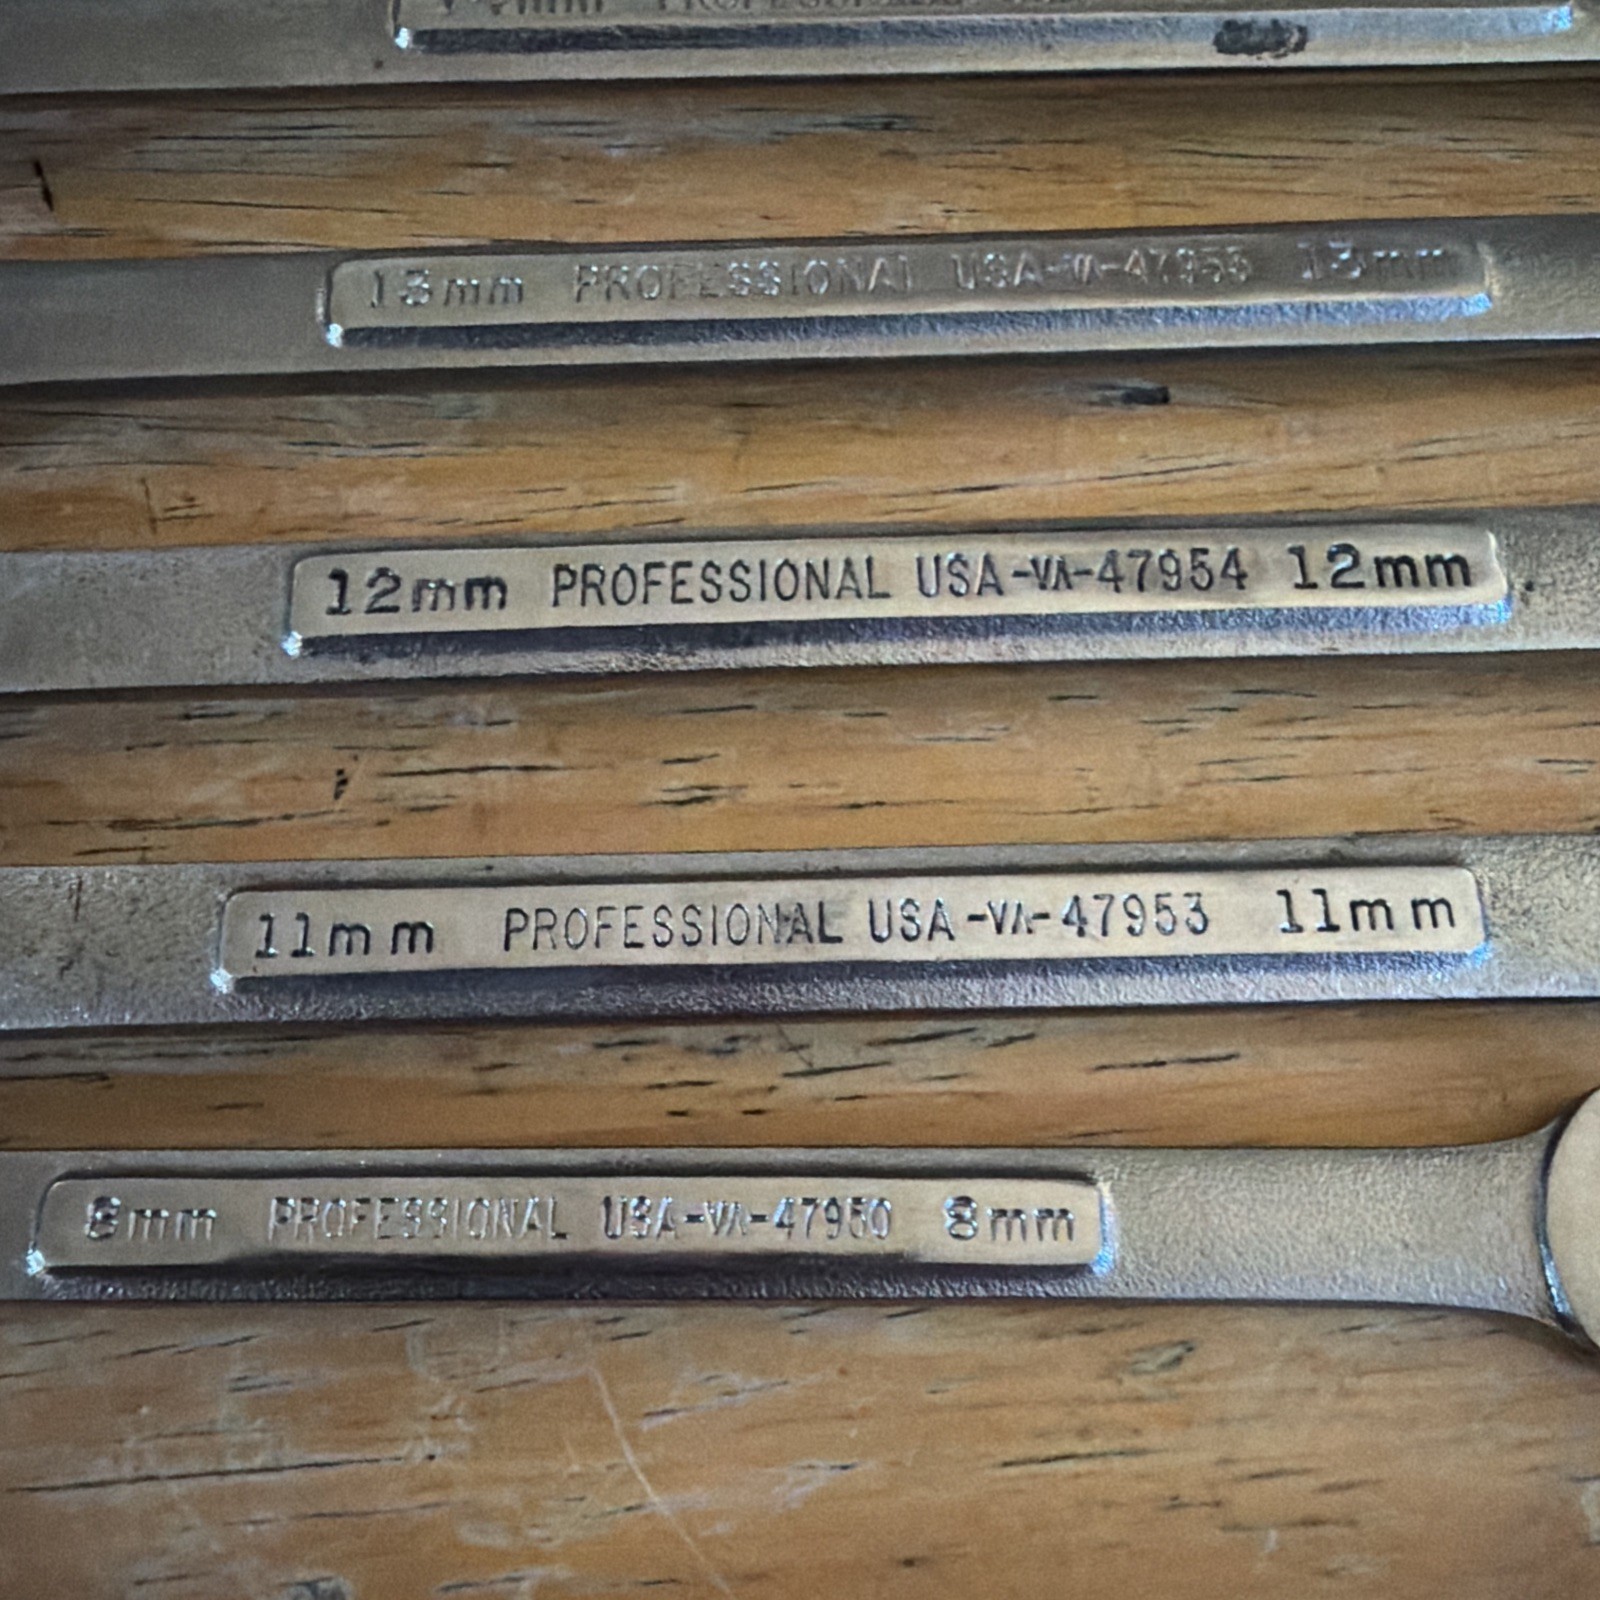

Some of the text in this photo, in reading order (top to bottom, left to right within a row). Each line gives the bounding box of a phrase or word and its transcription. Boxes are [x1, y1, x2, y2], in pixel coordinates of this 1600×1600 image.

[369, 268, 524, 308] 13mm
[325, 566, 507, 615] 12mm
[552, 554, 892, 607] PROFESSIONAL
[1288, 542, 1473, 591] 12mm
[254, 911, 435, 959] 11mm
[503, 900, 844, 953] PROFESSIONAL
[1277, 887, 1456, 935] 11mm
[84, 1195, 217, 1240] 8mm
[268, 1195, 570, 1241] PROFESSIONAL
[943, 1194, 1075, 1241] 8mm
